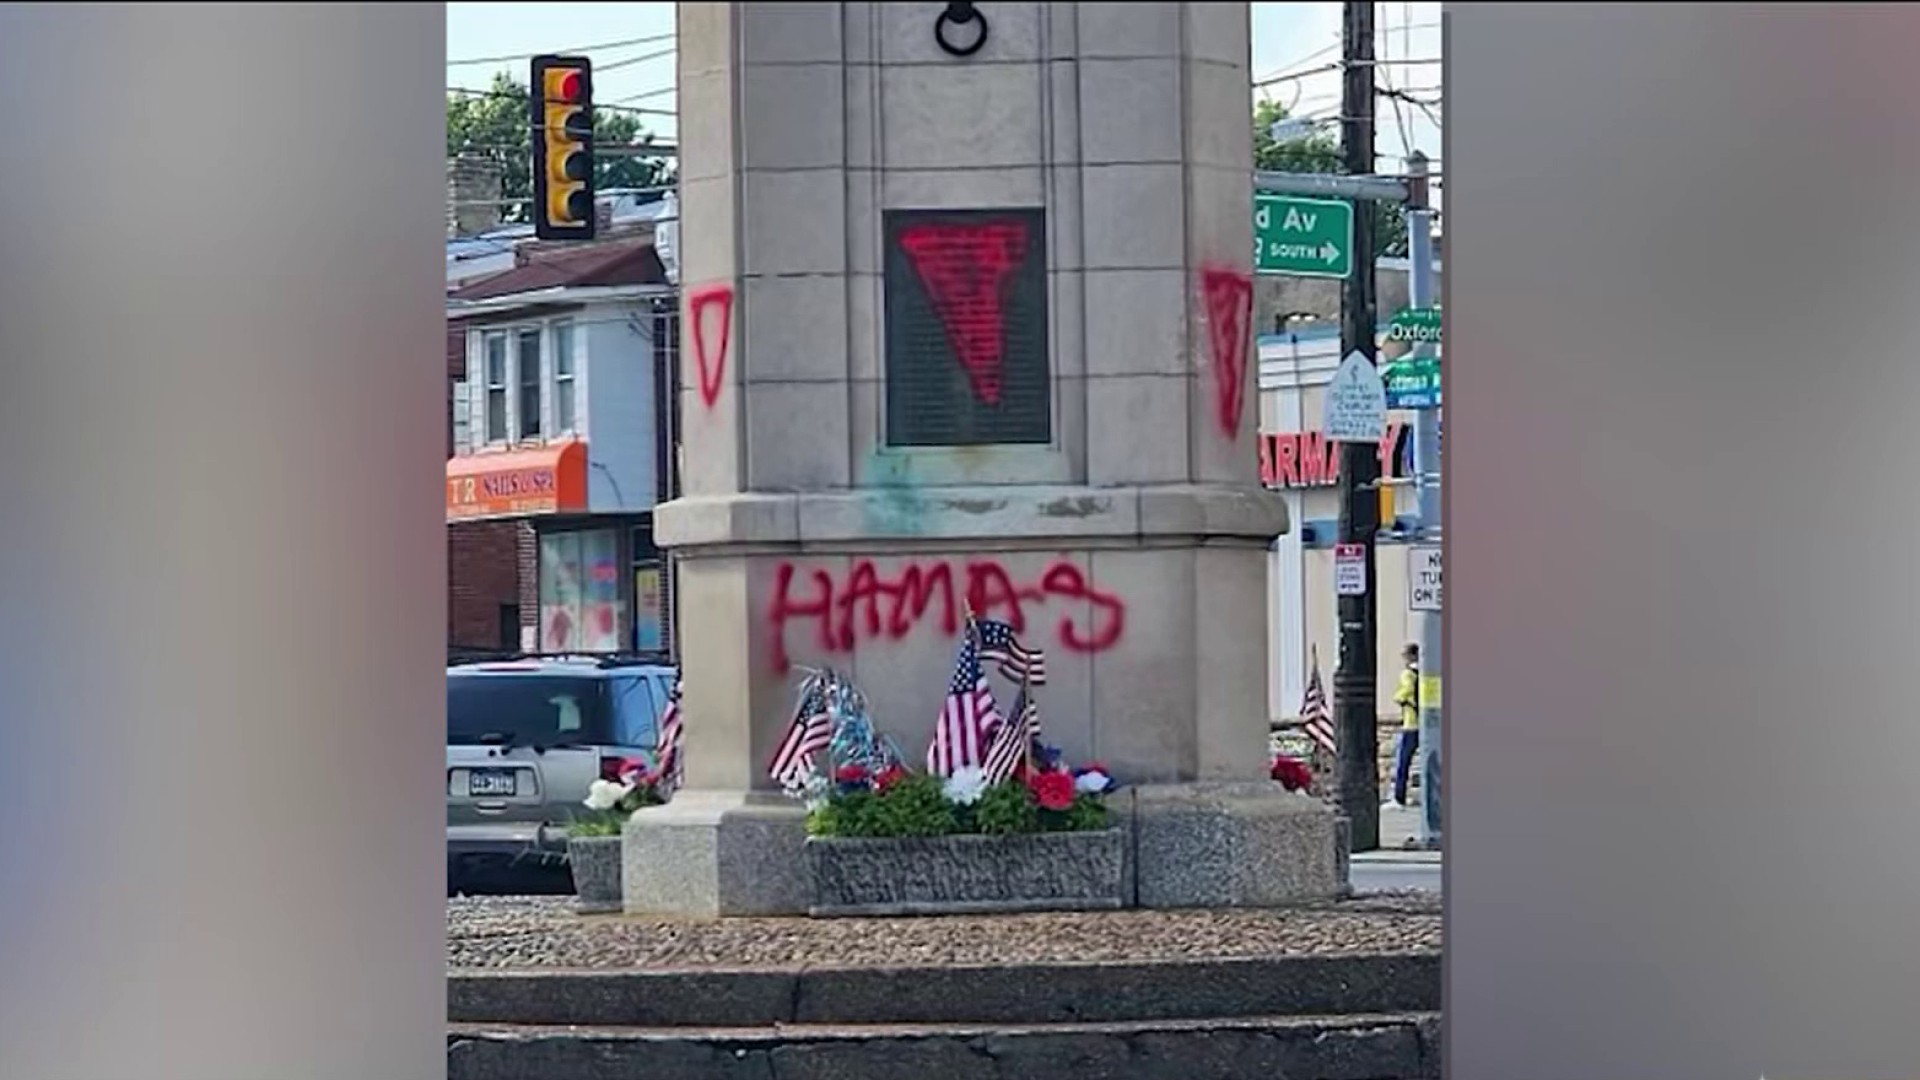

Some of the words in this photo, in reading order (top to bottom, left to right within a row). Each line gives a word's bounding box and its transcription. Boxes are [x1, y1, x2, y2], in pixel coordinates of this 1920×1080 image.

[1283, 206, 1317, 232] Av
[1270, 242, 1318, 259] SOUTH
[483, 472, 518, 498] NAILS
[1421, 571, 1442, 584] TU
[1414, 588, 1433, 602] ON
[770, 558, 1124, 674] HAMAS
